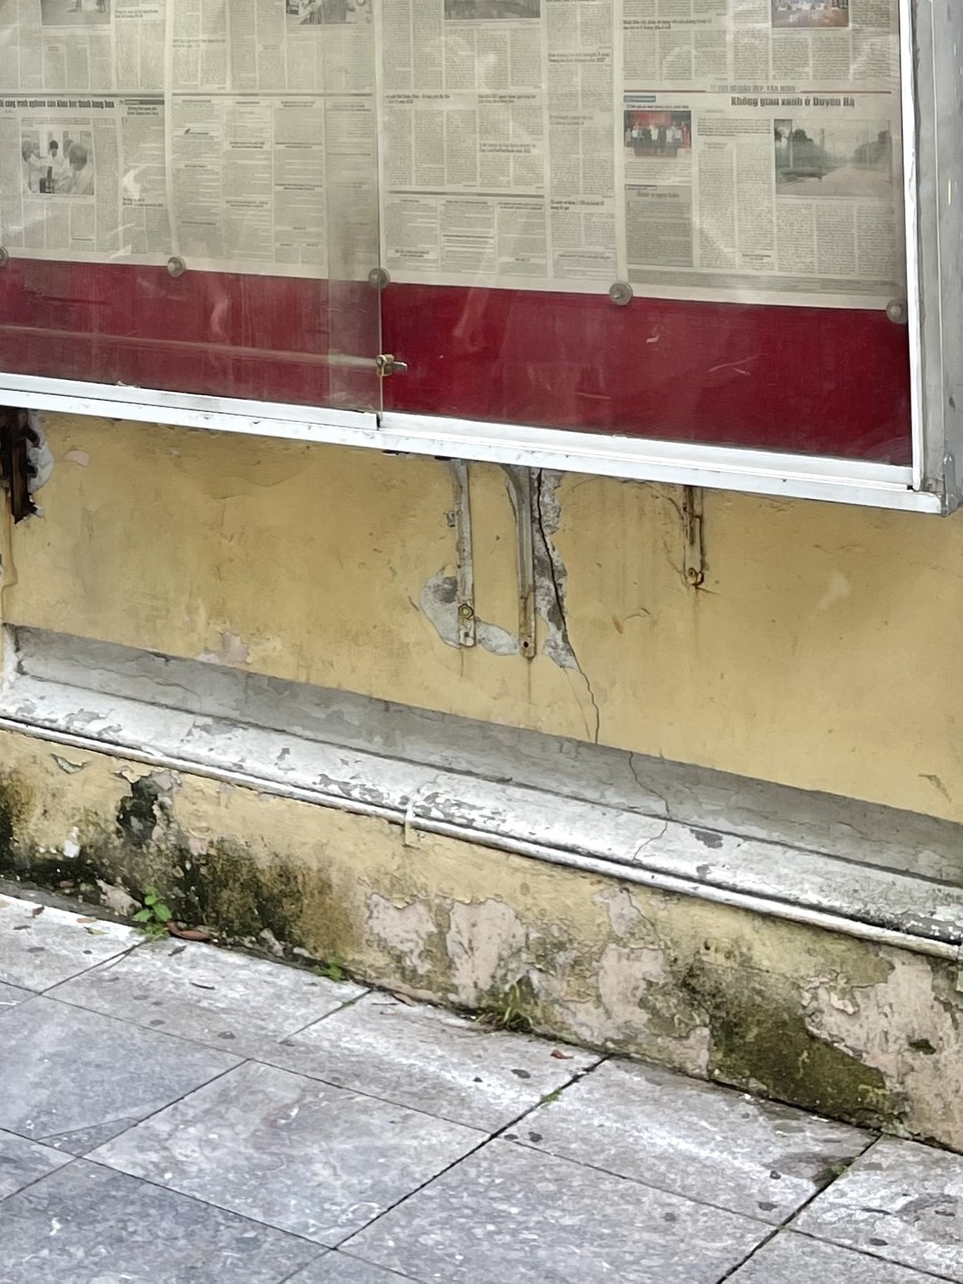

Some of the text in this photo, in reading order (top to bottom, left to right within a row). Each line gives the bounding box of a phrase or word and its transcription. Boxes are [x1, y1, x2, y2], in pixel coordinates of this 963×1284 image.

[731, 96, 758, 107] Không
[760, 97, 779, 107] gian
[781, 96, 803, 106] xanh
